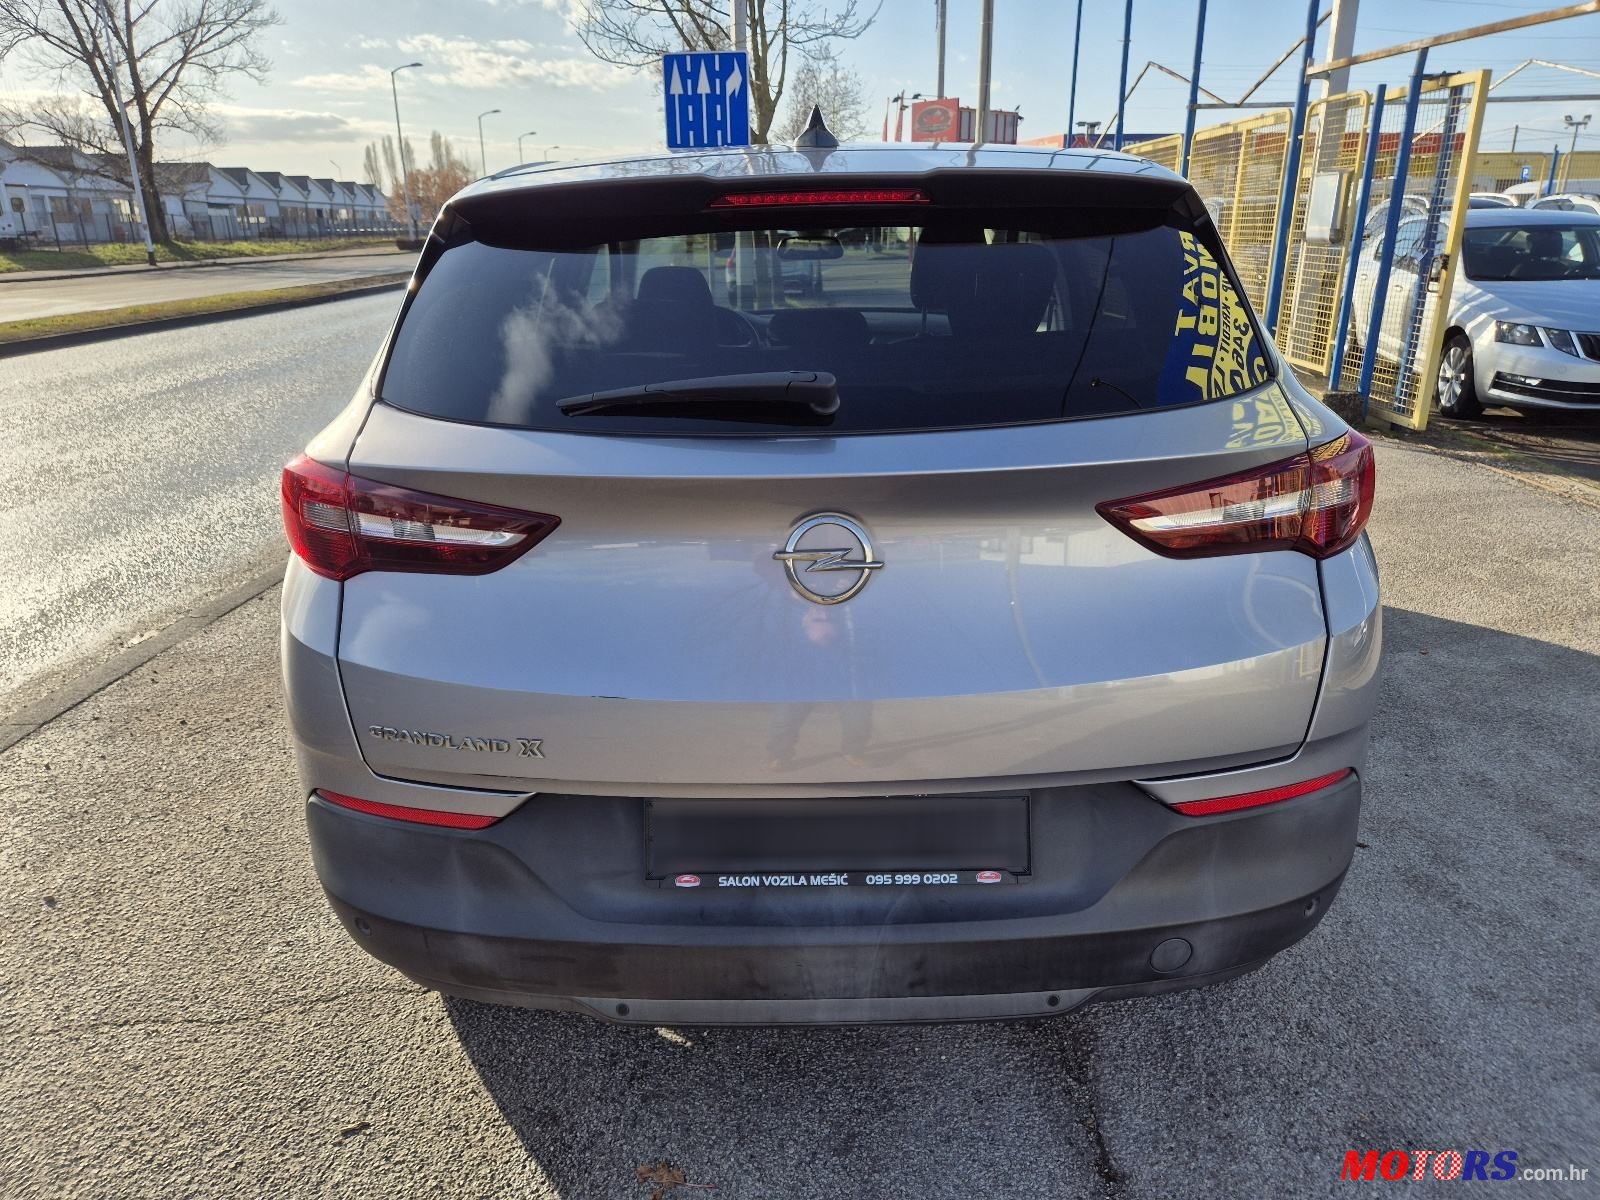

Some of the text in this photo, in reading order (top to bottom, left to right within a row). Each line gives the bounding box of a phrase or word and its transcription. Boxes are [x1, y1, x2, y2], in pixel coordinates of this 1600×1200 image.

[369, 725, 544, 758] GRANDLAND X
[718, 873, 958, 887] SALON VOZILA MEŠIĆ 095 999 0202
